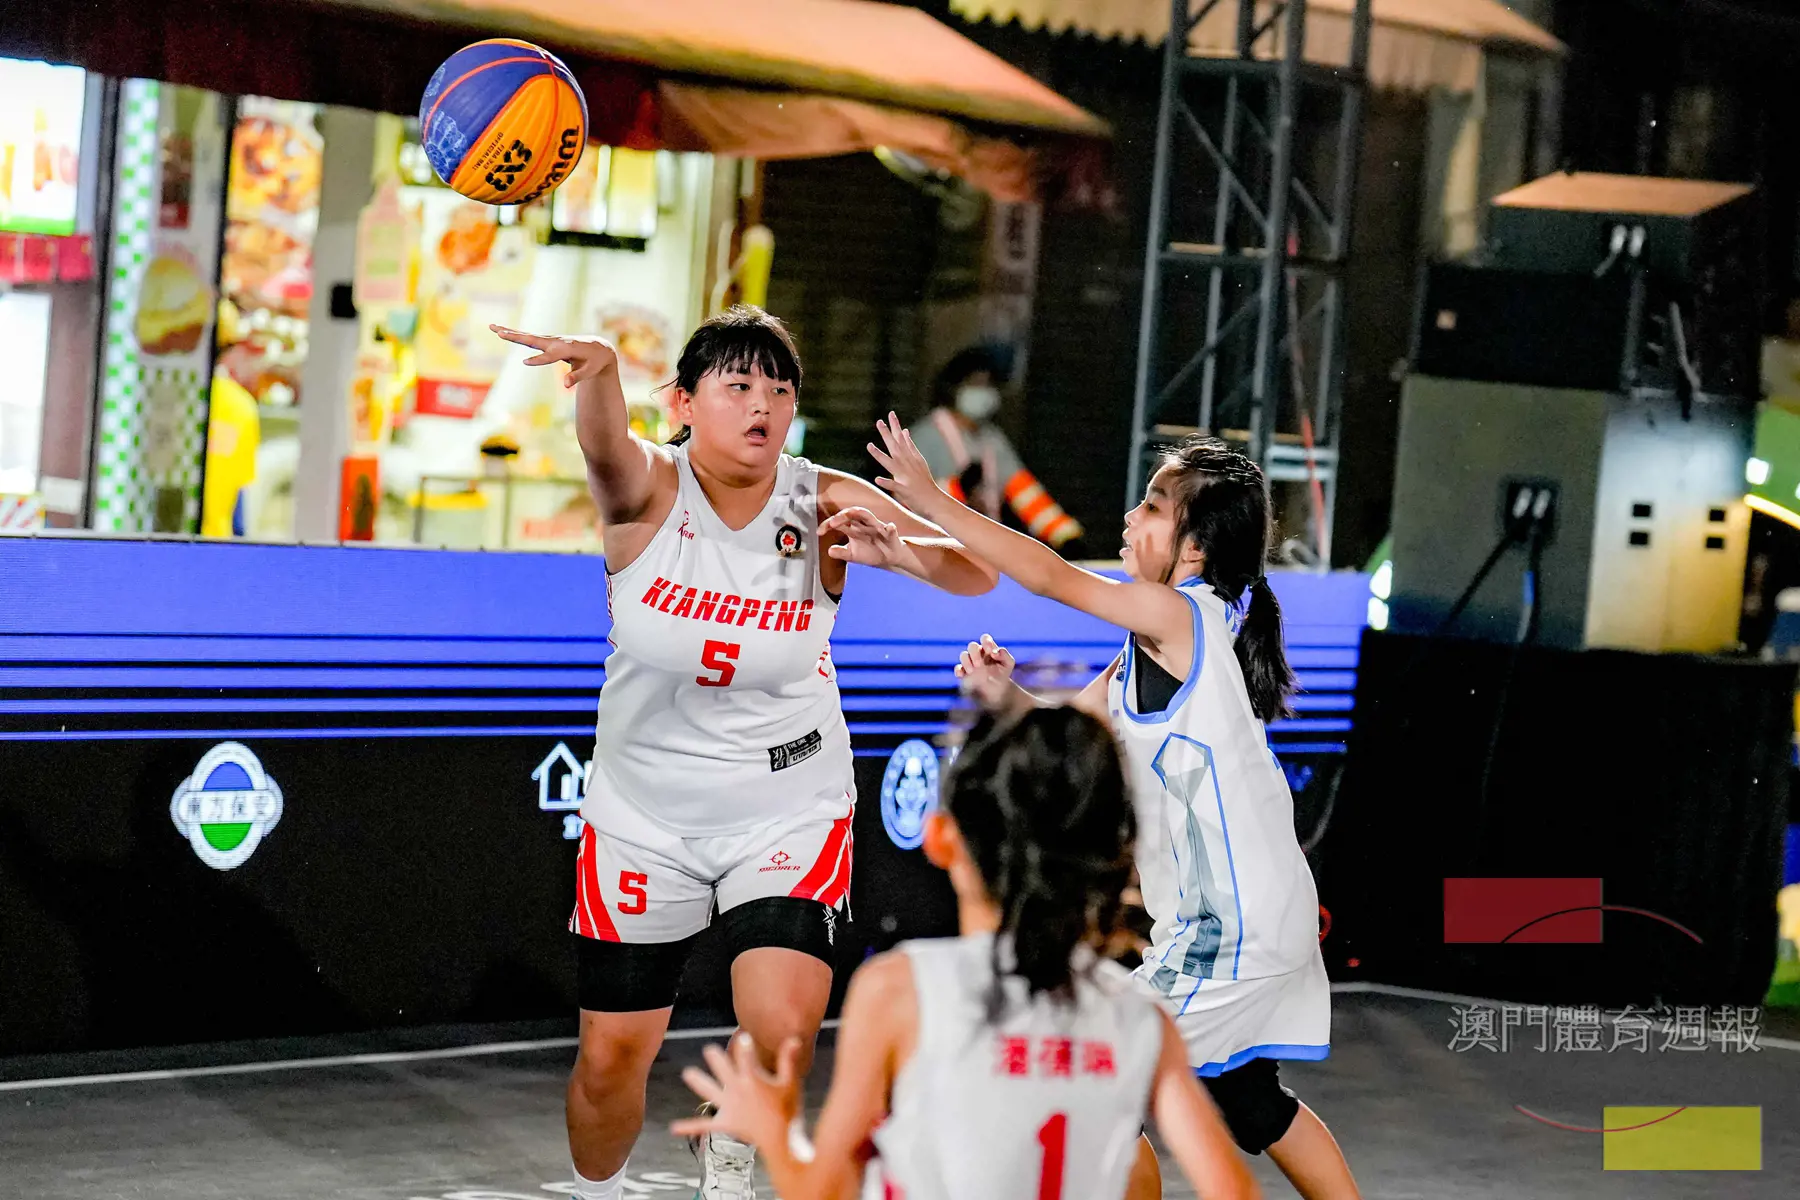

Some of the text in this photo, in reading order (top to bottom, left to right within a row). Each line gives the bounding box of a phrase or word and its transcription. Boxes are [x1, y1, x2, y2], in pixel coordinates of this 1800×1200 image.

[641, 576, 814, 632] KEANGPENG
[696, 639, 741, 687] 5
[617, 870, 648, 915] 5
[1036, 1113, 1068, 1200] 1
